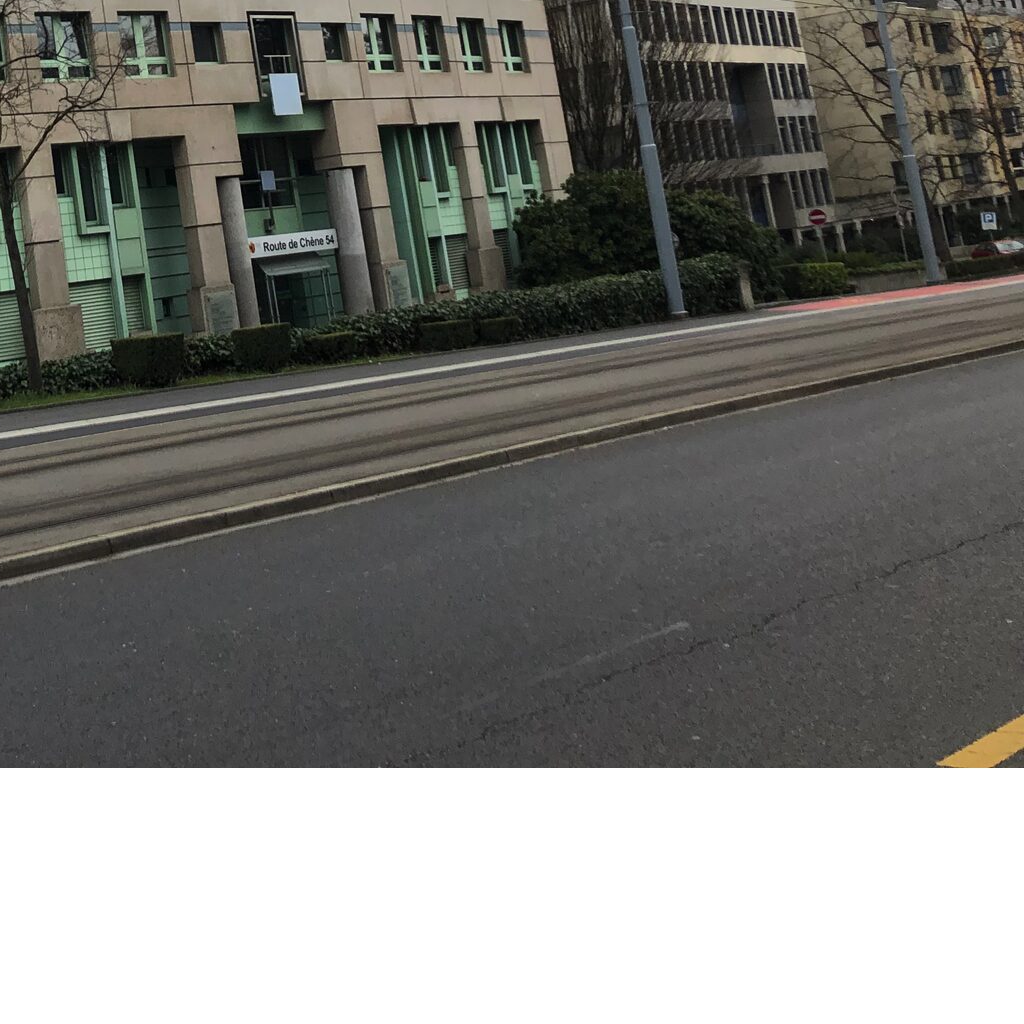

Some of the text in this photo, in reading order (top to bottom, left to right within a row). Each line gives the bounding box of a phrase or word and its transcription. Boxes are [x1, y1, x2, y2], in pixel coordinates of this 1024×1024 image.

[263, 241, 287, 252] Route
[288, 239, 298, 249] de
[325, 234, 335, 245] 54
